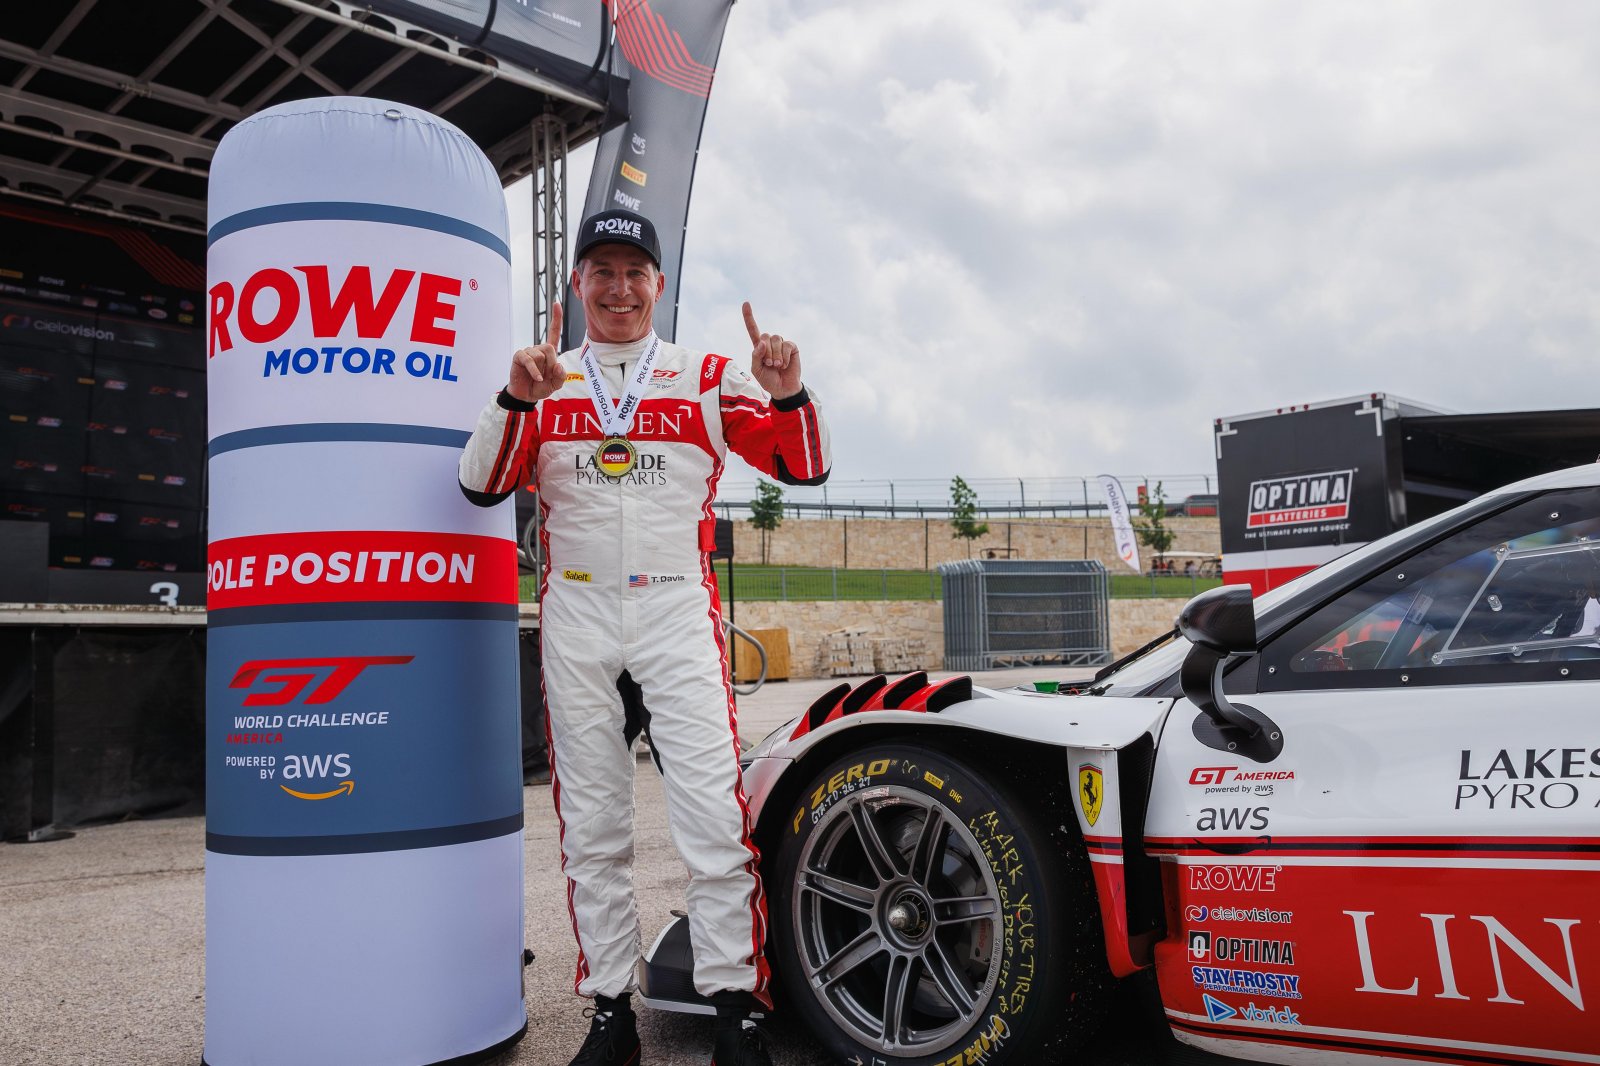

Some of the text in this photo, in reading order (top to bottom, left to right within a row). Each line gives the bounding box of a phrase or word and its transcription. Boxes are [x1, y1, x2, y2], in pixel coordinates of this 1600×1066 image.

[614, 189, 641, 211] ROWE
[595, 217, 642, 234] ROWE
[631, 232, 642, 240] OIL
[208, 265, 462, 359] ROWE
[33, 319, 115, 342] cielovision
[263, 347, 458, 383] MOTOR OIL
[636, 365, 649, 385] POLE
[592, 378, 611, 416] POSITION
[618, 393, 636, 420] ROWE
[626, 471, 667, 486] ARTS
[1253, 477, 1346, 510] OPTIMA
[1269, 508, 1328, 523] BATTERIES
[1258, 528, 1291, 538] ULTIMATE
[1292, 526, 1318, 535] POWER
[1320, 523, 1349, 532] SOURCE
[207, 551, 475, 593] POLE POSITION
[565, 570, 589, 582] Sabelt
[660, 574, 685, 583] Davis
[150, 582, 180, 607] 3
[228, 655, 416, 706] GT
[233, 711, 389, 729] WORLD CHALLENGE
[225, 733, 284, 744] AMERICA
[225, 753, 352, 780] POWERED aws
[259, 768, 276, 780] BY
[1188, 766, 1295, 785] GT AMERICA
[793, 806, 805, 835] P
[810, 759, 891, 810] ZERO
[1205, 783, 1274, 795] powered by aws
[1454, 782, 1579, 810] PYRO
[1196, 806, 1270, 832] aws
[1188, 865, 1277, 892] ROWE
[980, 810, 1035, 1016] MARK YOUR TIRES
[1210, 906, 1293, 924] cielovision
[1215, 936, 1295, 966] OPTIMA
[1342, 910, 1585, 1012] LIN
[1203, 983, 1302, 999] PERFORMANCE COOLANTS
[1240, 1001, 1302, 1025] vbrick
